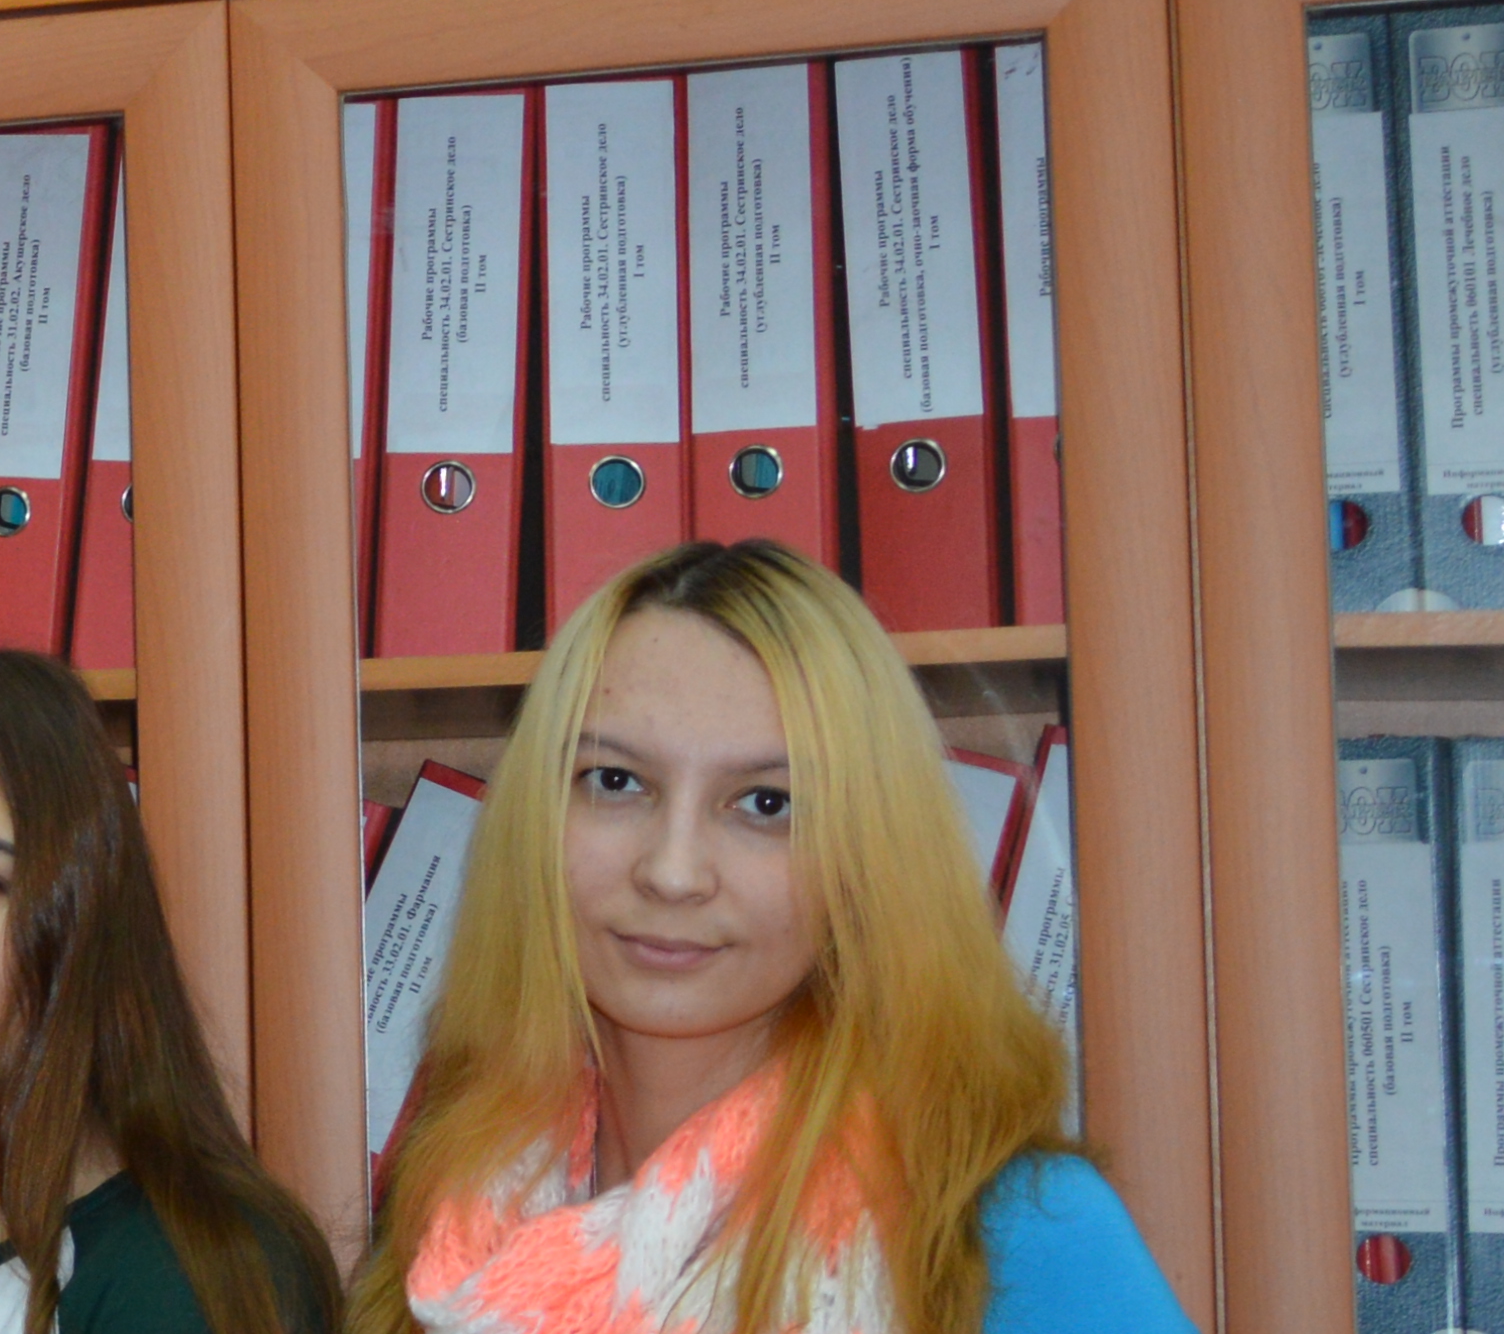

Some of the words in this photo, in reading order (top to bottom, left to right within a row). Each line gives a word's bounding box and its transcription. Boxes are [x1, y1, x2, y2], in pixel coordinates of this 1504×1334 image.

[886, 94, 898, 125] дело
[899, 54, 915, 125] обучения)
[888, 127, 904, 215] Сестринское
[904, 127, 920, 173] форма
[1459, 155, 1473, 187] дело
[873, 169, 889, 248] программы
[1439, 144, 1454, 225] аттестации
[891, 218, 906, 274] 34.02.01.
[909, 175, 924, 267] очно-заочная
[929, 214, 940, 240] том
[1459, 190, 1476, 256] Лечебное
[876, 252, 891, 307] Рабочие
[914, 269, 929, 351] подготовка,
[1444, 227, 1460, 340] промежуточной
[1462, 260, 1478, 308] 060101
[897, 277, 912, 379] специальность
[918, 354, 933, 413] (базовая
[1448, 343, 1466, 429] Программы
[1468, 309, 1484, 416] специальность
[1356, 879, 1369, 911] дело
[1357, 914, 1373, 1005] Сестринское
[1379, 944, 1394, 1031] подготовка)
[1359, 1009, 1375, 1057] 060501
[1402, 1000, 1413, 1026] том
[1381, 1035, 1396, 1096] (базовая
[1364, 1060, 1379, 1166] специальность
